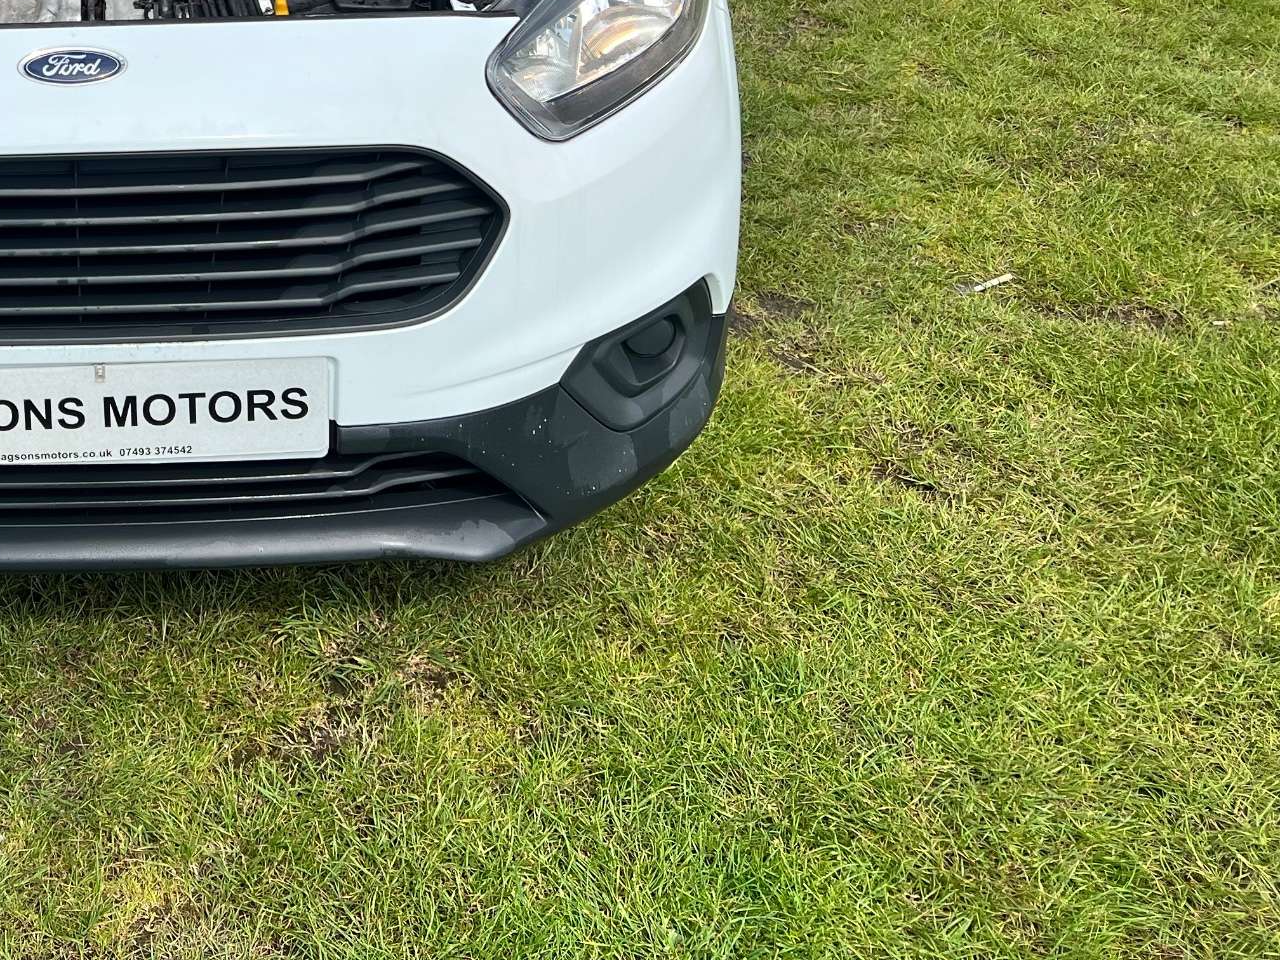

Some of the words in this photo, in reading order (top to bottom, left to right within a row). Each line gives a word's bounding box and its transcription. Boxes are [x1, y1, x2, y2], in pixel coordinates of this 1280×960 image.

[42, 54, 102, 77] Ford
[103, 387, 309, 428] MOTORS
[119, 447, 152, 457] 07493
[154, 445, 193, 456] 374542
